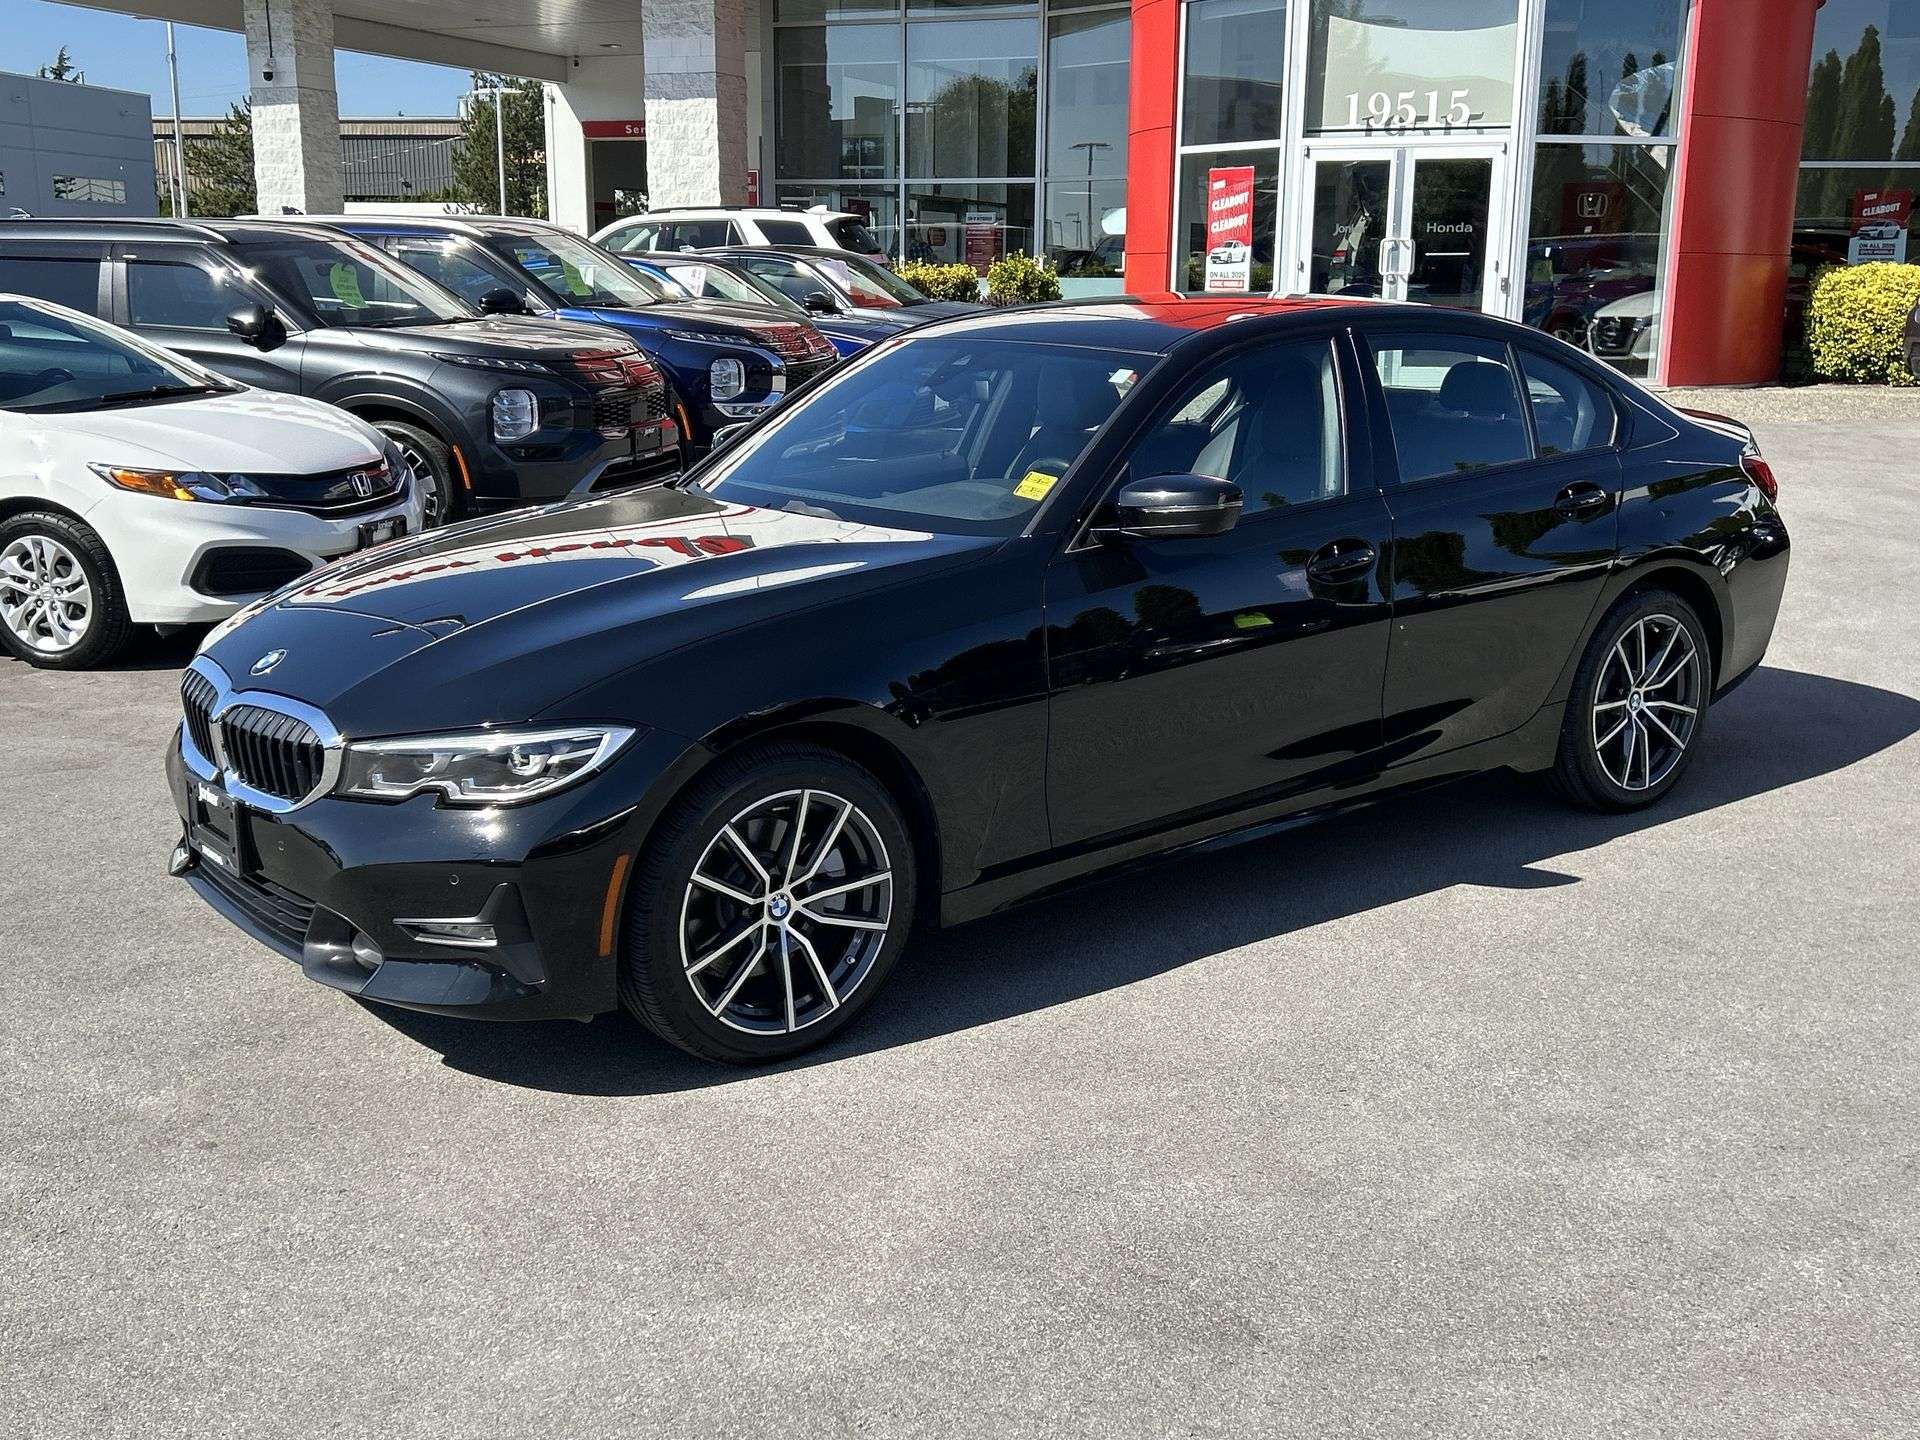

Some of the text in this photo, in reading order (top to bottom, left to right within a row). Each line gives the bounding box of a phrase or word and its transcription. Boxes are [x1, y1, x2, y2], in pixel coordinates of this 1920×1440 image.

[1344, 88, 1472, 128] 19515
[1862, 203, 1901, 216] CLEAROUT
[1426, 222, 1473, 233] Honda
[1209, 271, 1218, 279] ON
[1219, 271, 1230, 279] ALL
